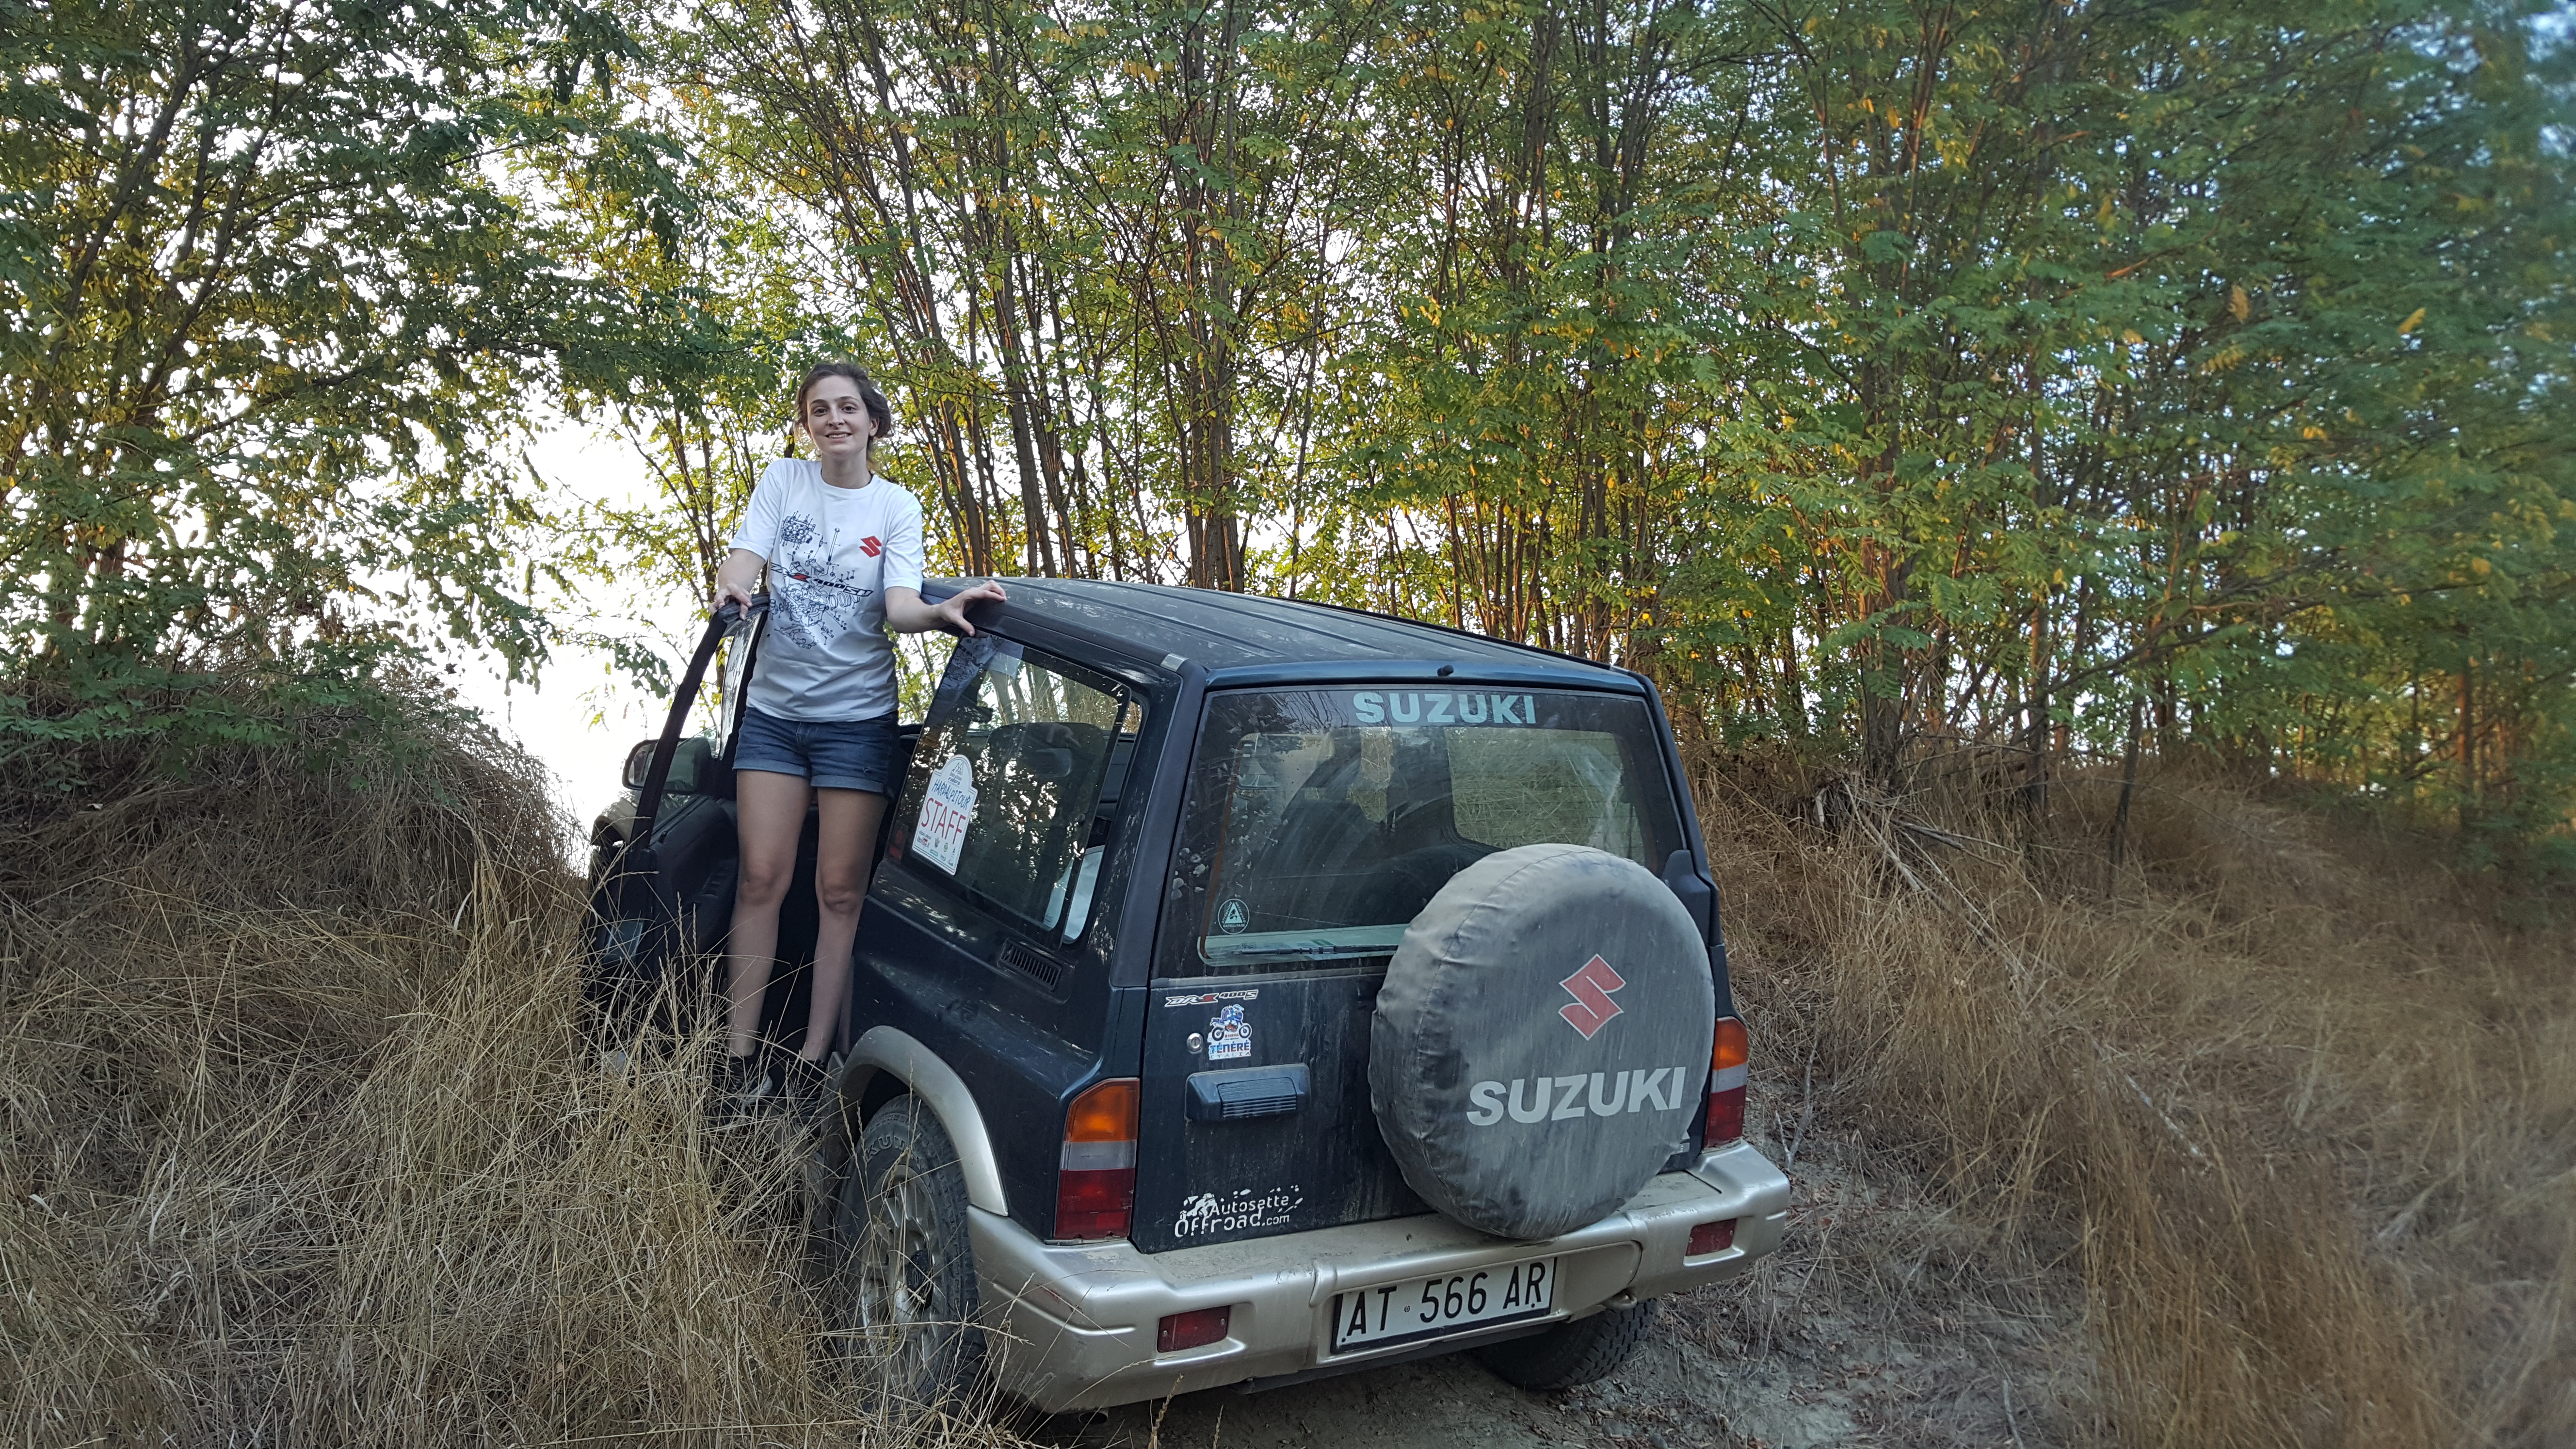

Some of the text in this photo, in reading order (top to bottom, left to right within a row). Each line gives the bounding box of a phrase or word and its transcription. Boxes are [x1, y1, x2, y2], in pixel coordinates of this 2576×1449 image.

[1353, 692, 1537, 724] SUZUKI
[932, 779, 971, 810] HARDALPITOUR
[921, 798, 966, 844] STAFF
[1219, 989, 1258, 1000] 400S
[1466, 1067, 1686, 1126] SUZUKI
[1210, 1195, 1289, 1216] Autosette
[1347, 1262, 1546, 1336] AT 566 AR
